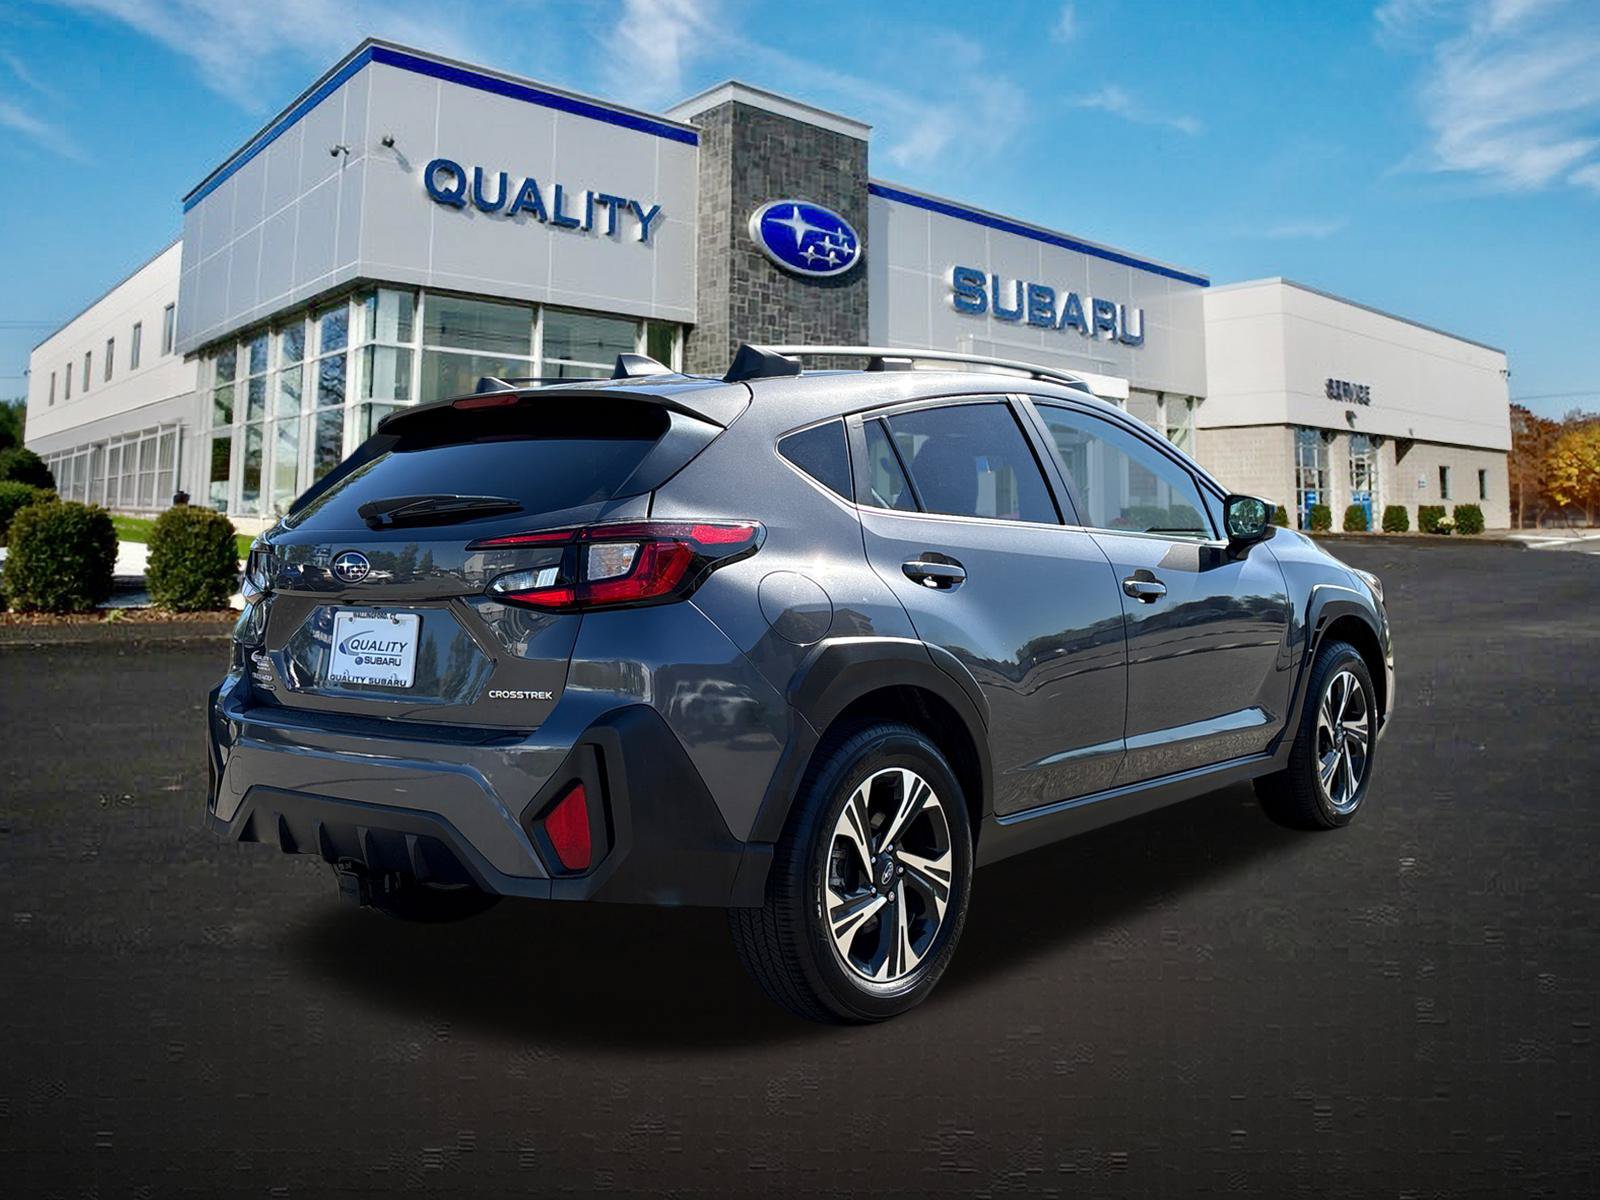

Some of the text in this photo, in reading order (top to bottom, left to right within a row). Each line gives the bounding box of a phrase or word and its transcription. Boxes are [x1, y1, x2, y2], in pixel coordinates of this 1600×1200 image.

[424, 157, 661, 243] QUALITY
[950, 265, 1145, 346] SUBARU
[350, 639, 408, 653] QUALITY
[364, 656, 402, 667] SUBARU
[329, 674, 407, 687] QUALITY SUBARU
[488, 690, 553, 700] CROSSTREK
